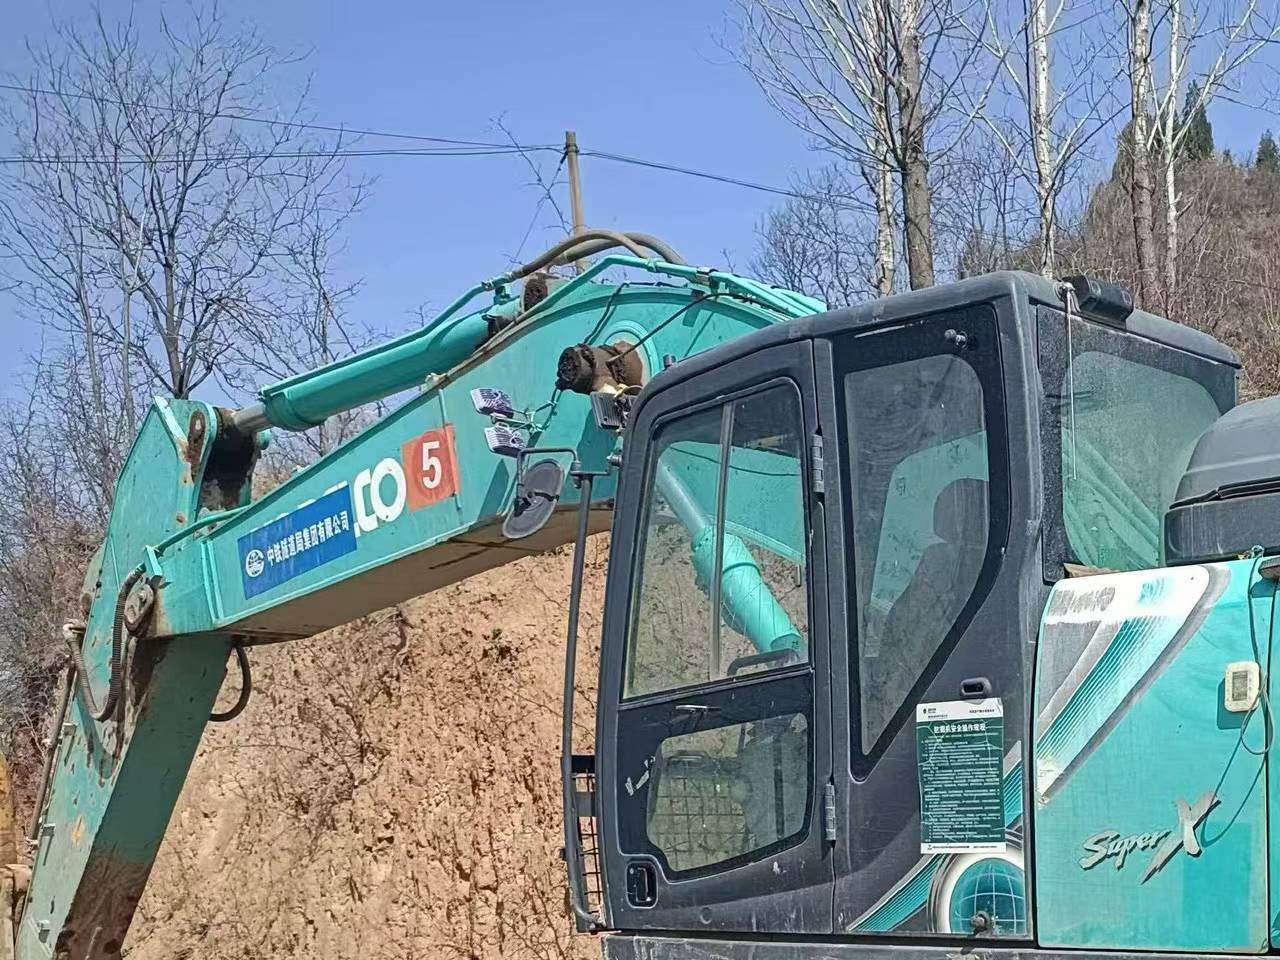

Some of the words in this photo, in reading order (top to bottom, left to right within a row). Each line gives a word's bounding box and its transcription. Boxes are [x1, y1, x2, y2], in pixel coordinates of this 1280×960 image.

[422, 441, 442, 489] 5
[353, 457, 407, 538] CO
[266, 510, 350, 567] 中铁隧道局集团有限公司
[1078, 830, 1172, 871] Super
